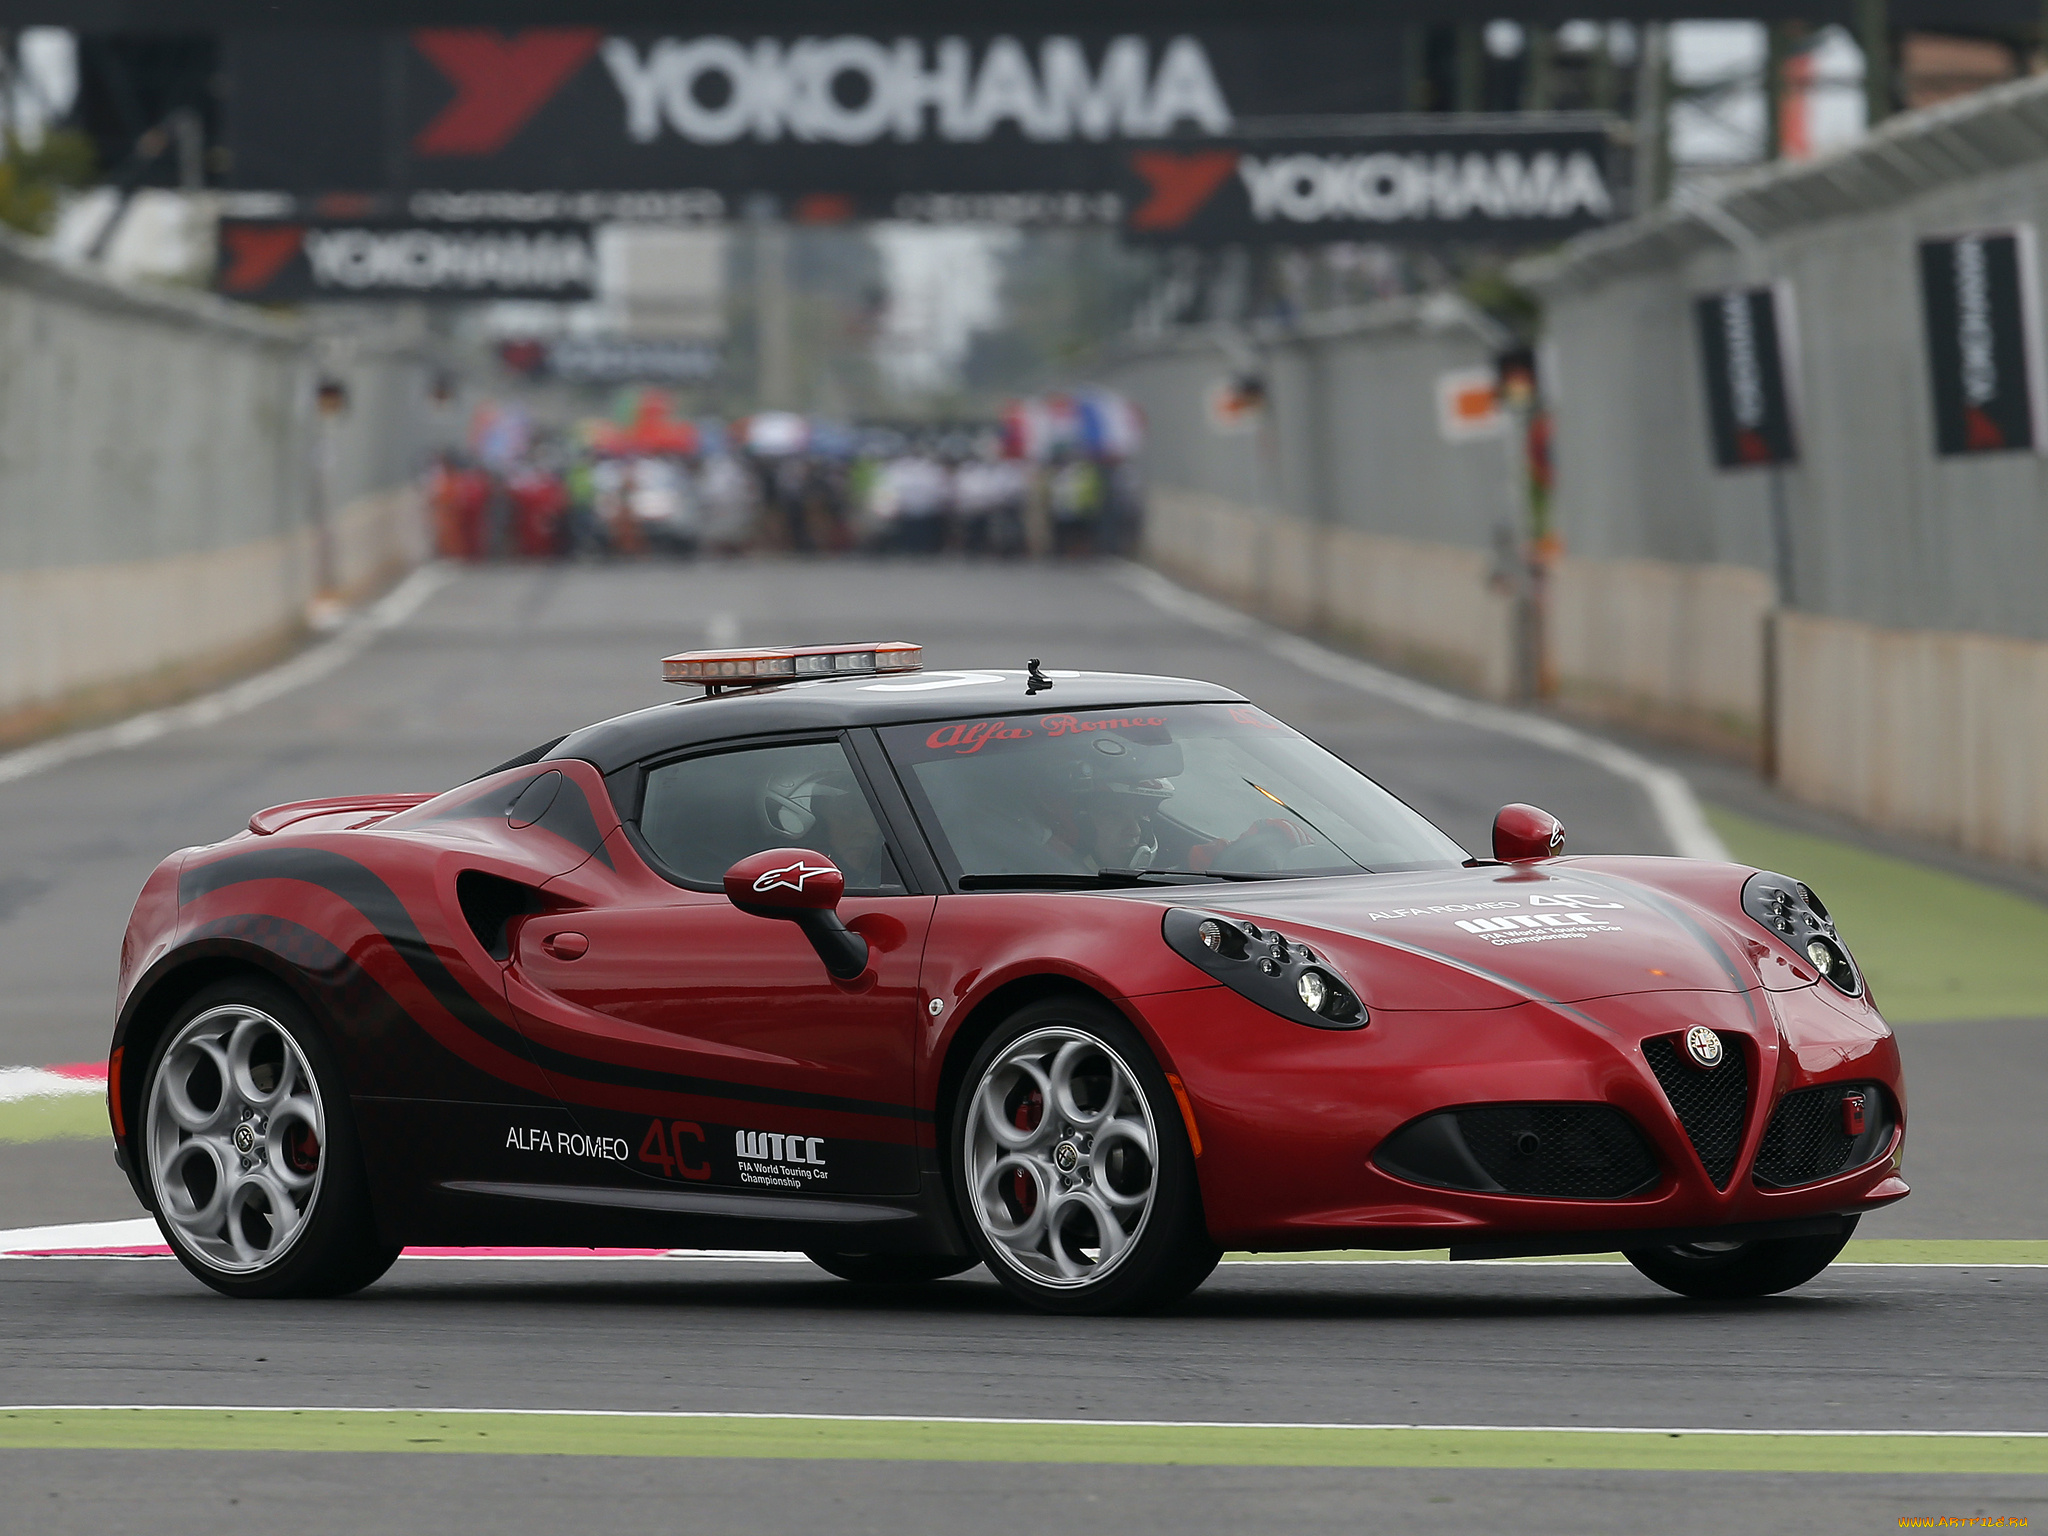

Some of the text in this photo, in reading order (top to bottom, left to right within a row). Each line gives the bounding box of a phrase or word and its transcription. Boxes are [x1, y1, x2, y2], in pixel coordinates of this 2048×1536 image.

[602, 36, 1232, 142] YOKOHAMA
[1238, 149, 1611, 222] YOKOHAMA
[925, 713, 1168, 754] Alfa Romeo
[1368, 894, 1625, 921] ALFA ROMEO 4C
[1454, 912, 1610, 934] WTCC
[1478, 924, 1623, 941] FIA World Touring Car
[1491, 931, 1589, 947] Championship
[506, 1118, 712, 1180] ALFA ROMEO 4C
[735, 1130, 826, 1165] WTCC
[738, 1161, 829, 1180] FIA World Touring Car
[740, 1172, 801, 1189] Championship
